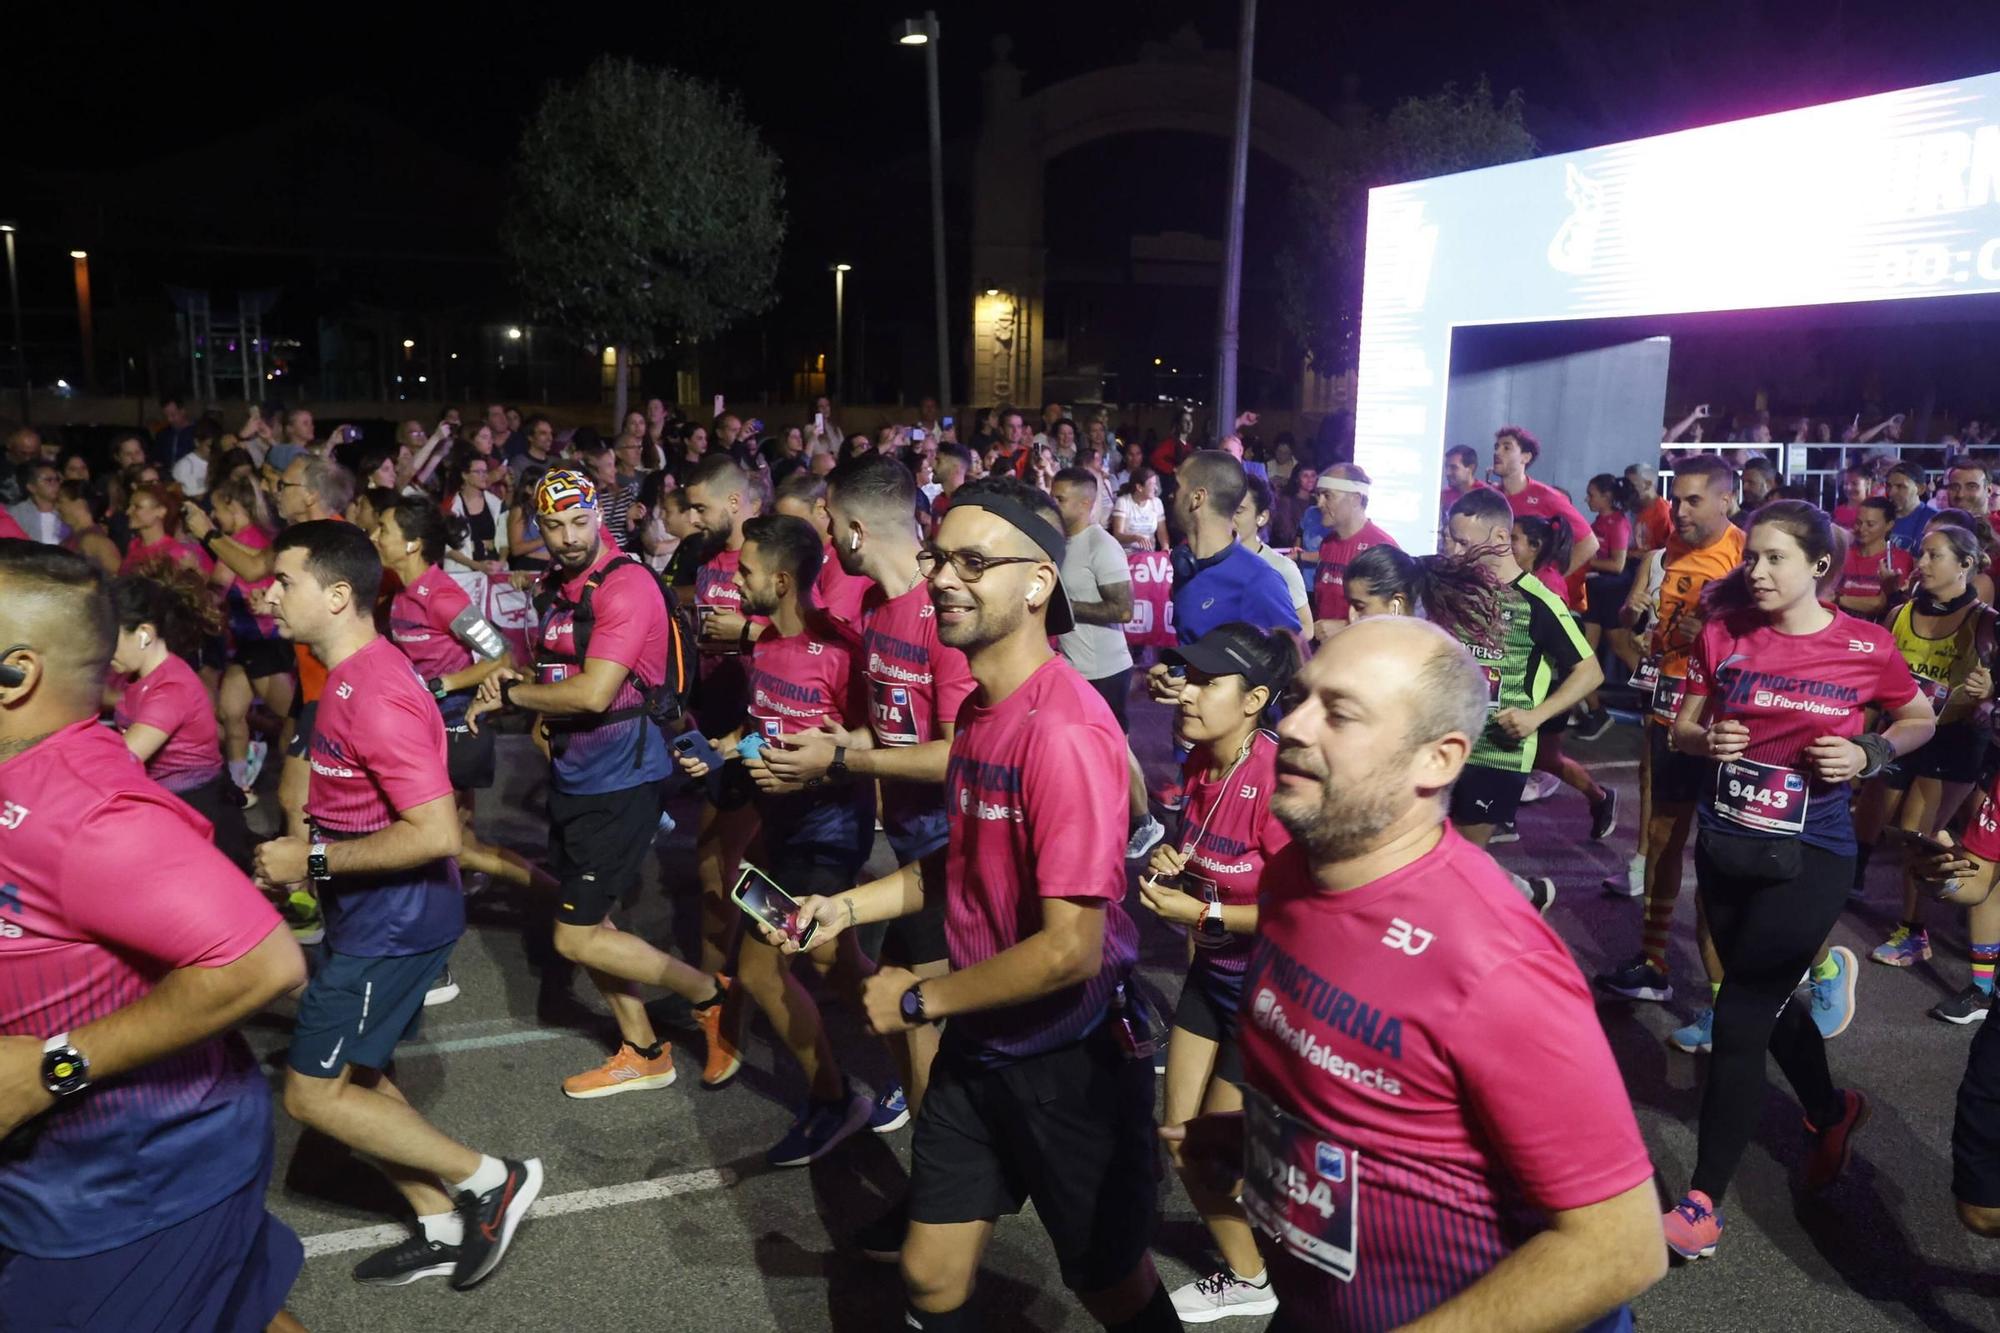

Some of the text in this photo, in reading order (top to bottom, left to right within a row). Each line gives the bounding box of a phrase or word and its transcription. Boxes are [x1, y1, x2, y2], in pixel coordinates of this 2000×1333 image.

[1760, 673, 1860, 702] NOCTURNA
[1729, 780, 1789, 809] 9443
[1270, 945, 1404, 1061] NOCTURNA
